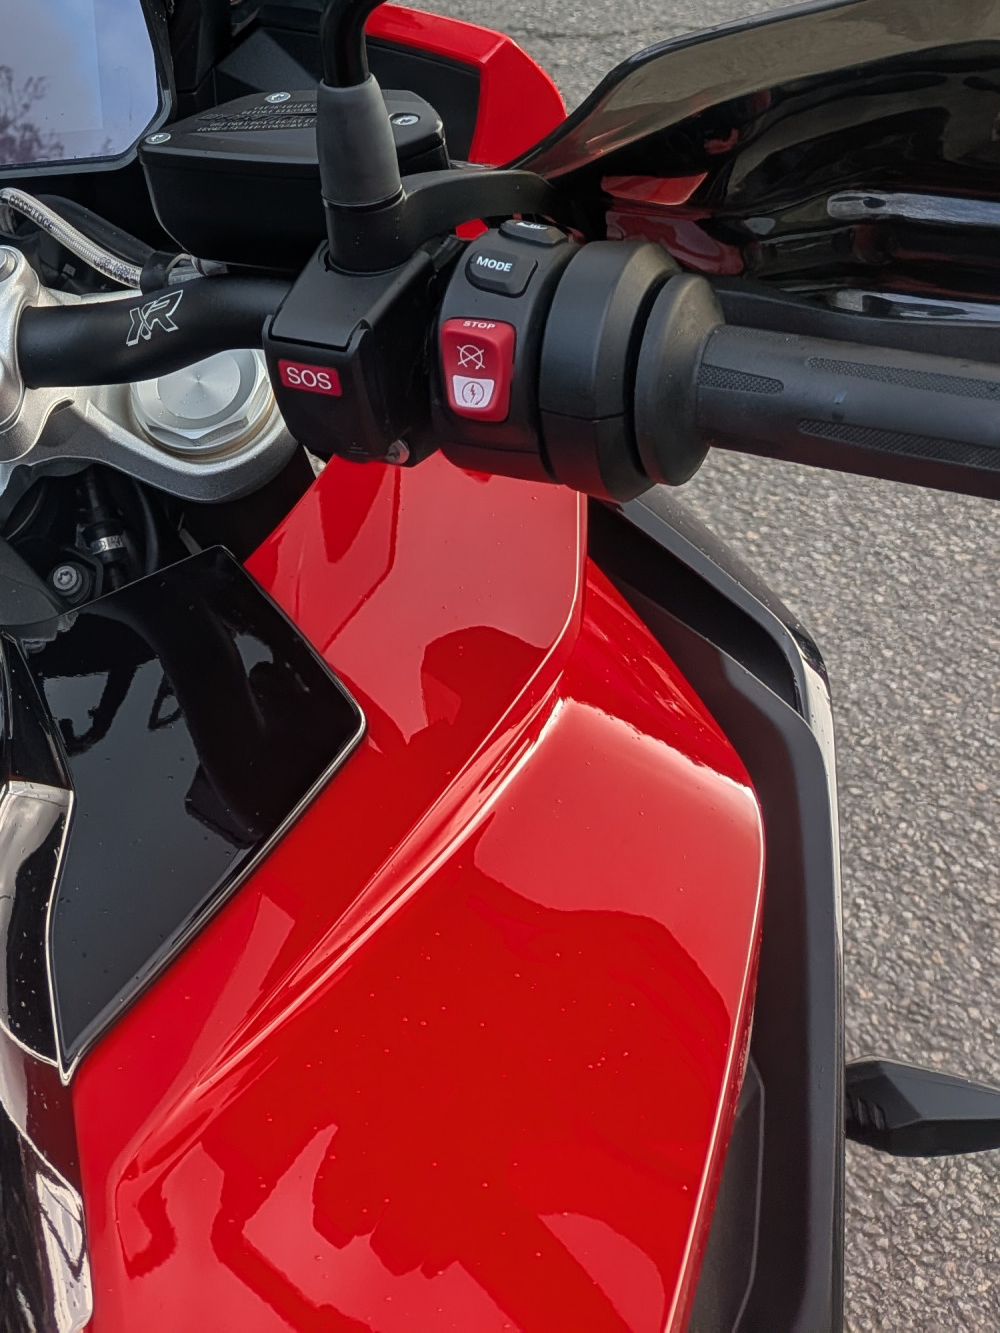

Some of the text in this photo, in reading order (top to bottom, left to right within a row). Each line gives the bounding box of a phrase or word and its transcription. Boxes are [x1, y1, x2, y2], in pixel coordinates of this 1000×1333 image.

[476, 255, 513, 272] MODE
[462, 320, 496, 329] STOP
[286, 366, 333, 390] SOS
